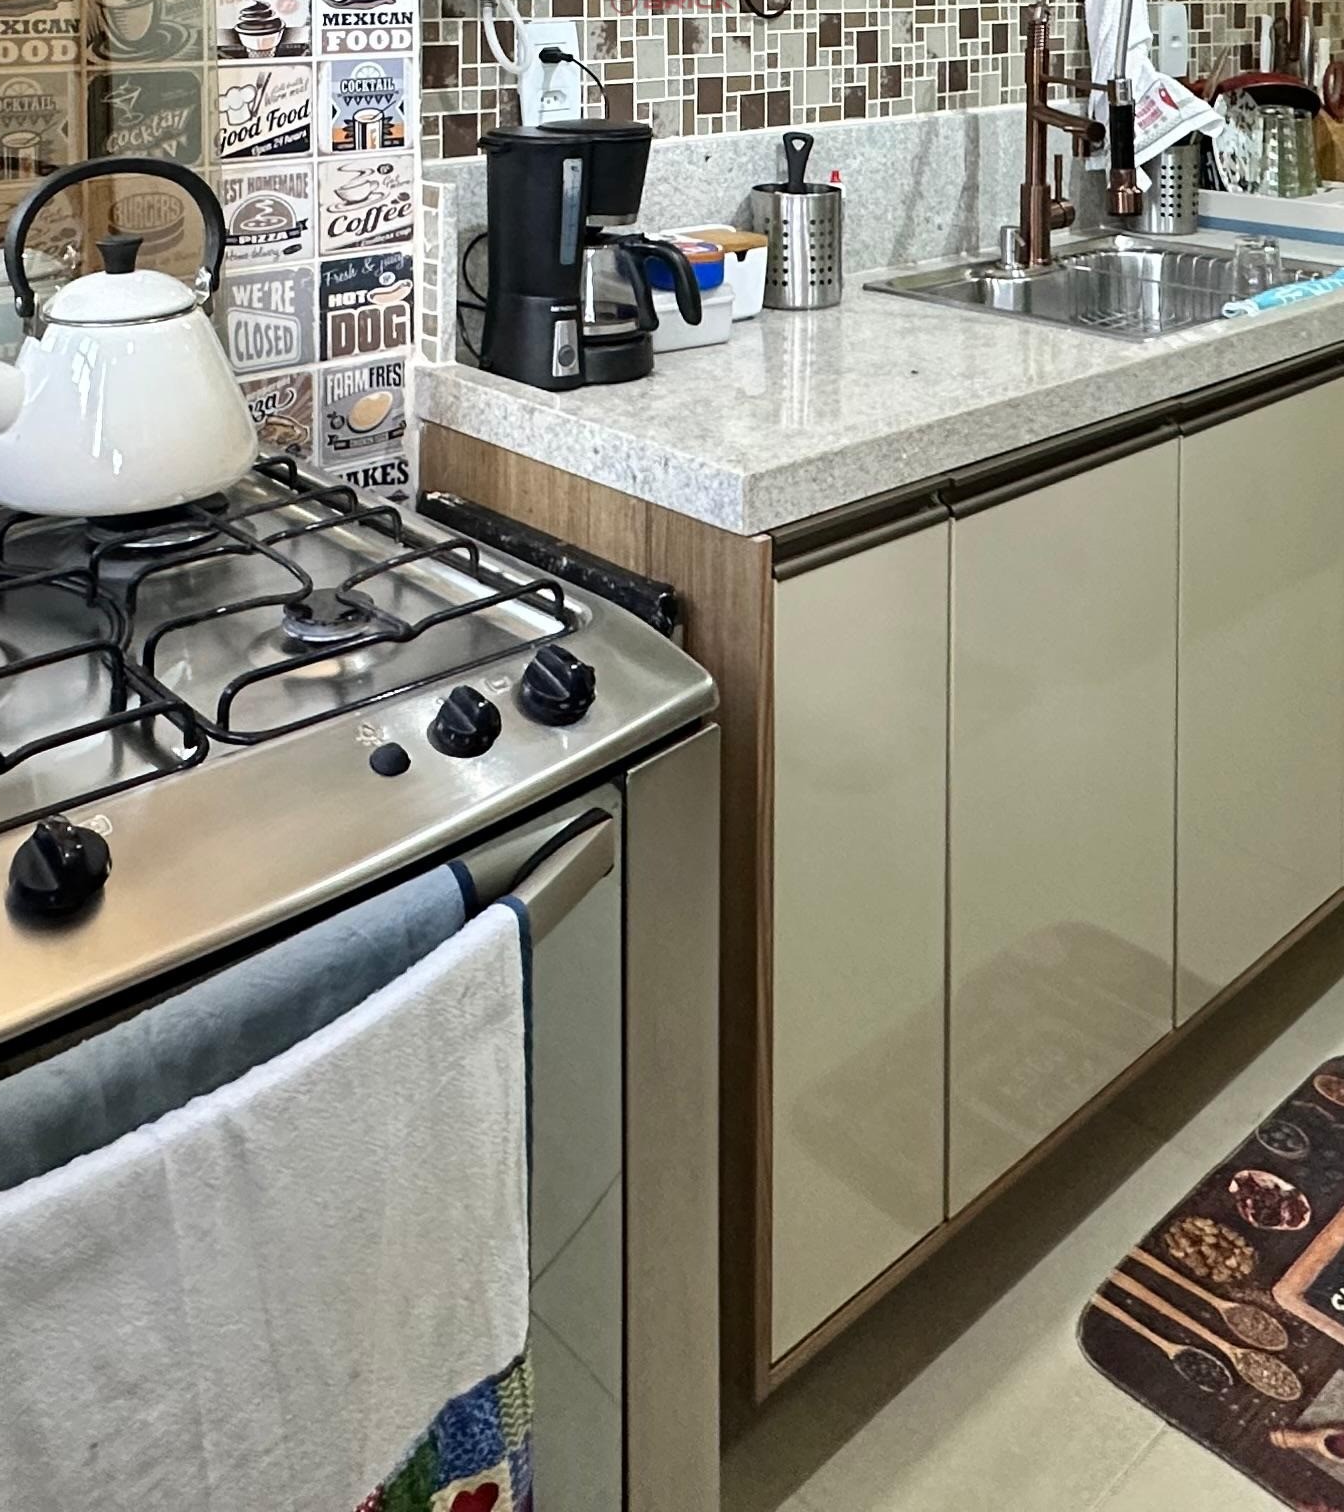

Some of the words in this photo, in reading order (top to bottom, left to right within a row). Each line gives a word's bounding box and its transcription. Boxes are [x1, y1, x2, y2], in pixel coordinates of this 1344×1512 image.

[322, 11, 412, 26] MEXICAN
[326, 29, 411, 50] FOOD
[327, 200, 412, 240] Coffee
[232, 280, 295, 313] WE'RE
[327, 293, 368, 307] HOT
[233, 319, 294, 357] CLOSED
[330, 305, 407, 353] DOG
